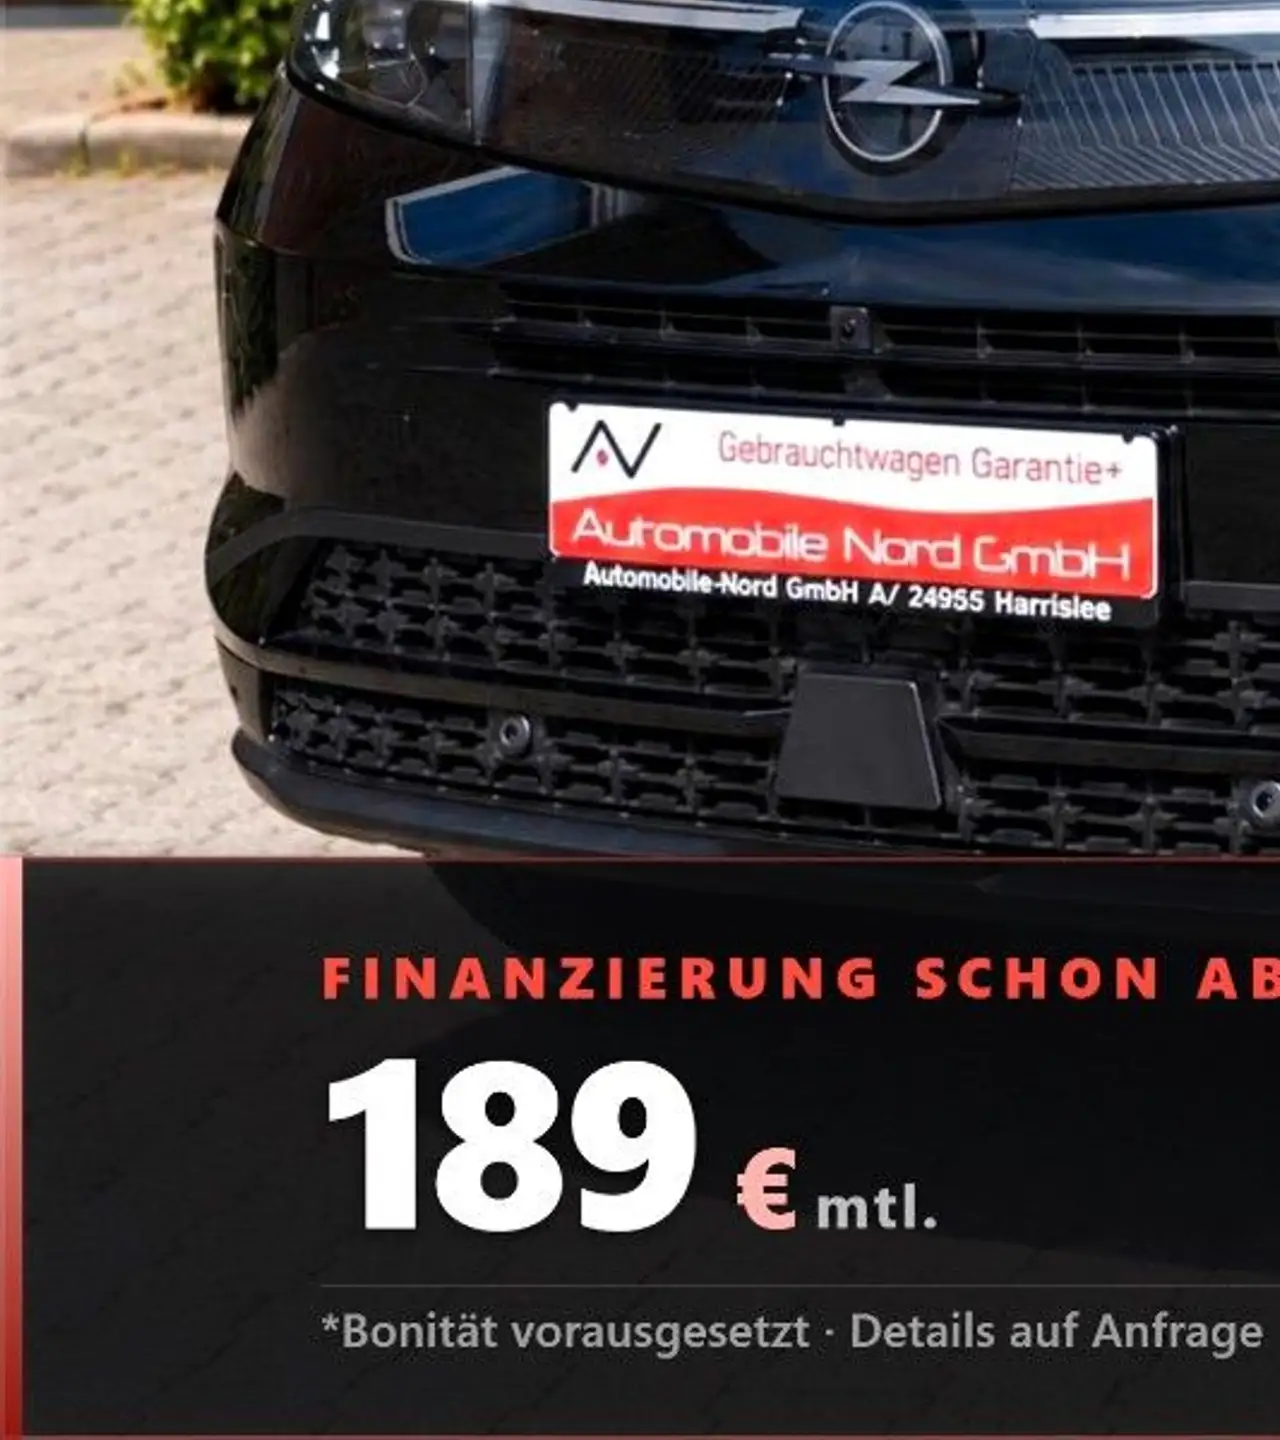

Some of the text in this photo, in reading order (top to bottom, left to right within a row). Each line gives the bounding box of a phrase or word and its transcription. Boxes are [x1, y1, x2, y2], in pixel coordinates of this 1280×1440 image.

[717, 430, 1124, 486] Gebrauchtwagen Garantie+
[570, 507, 1131, 583] Automobile Nord GmbH
[582, 561, 779, 600] Automobile-Nord
[785, 578, 860, 605] GmbH
[907, 585, 986, 613] 24955
[993, 591, 1113, 622] Harrislee
